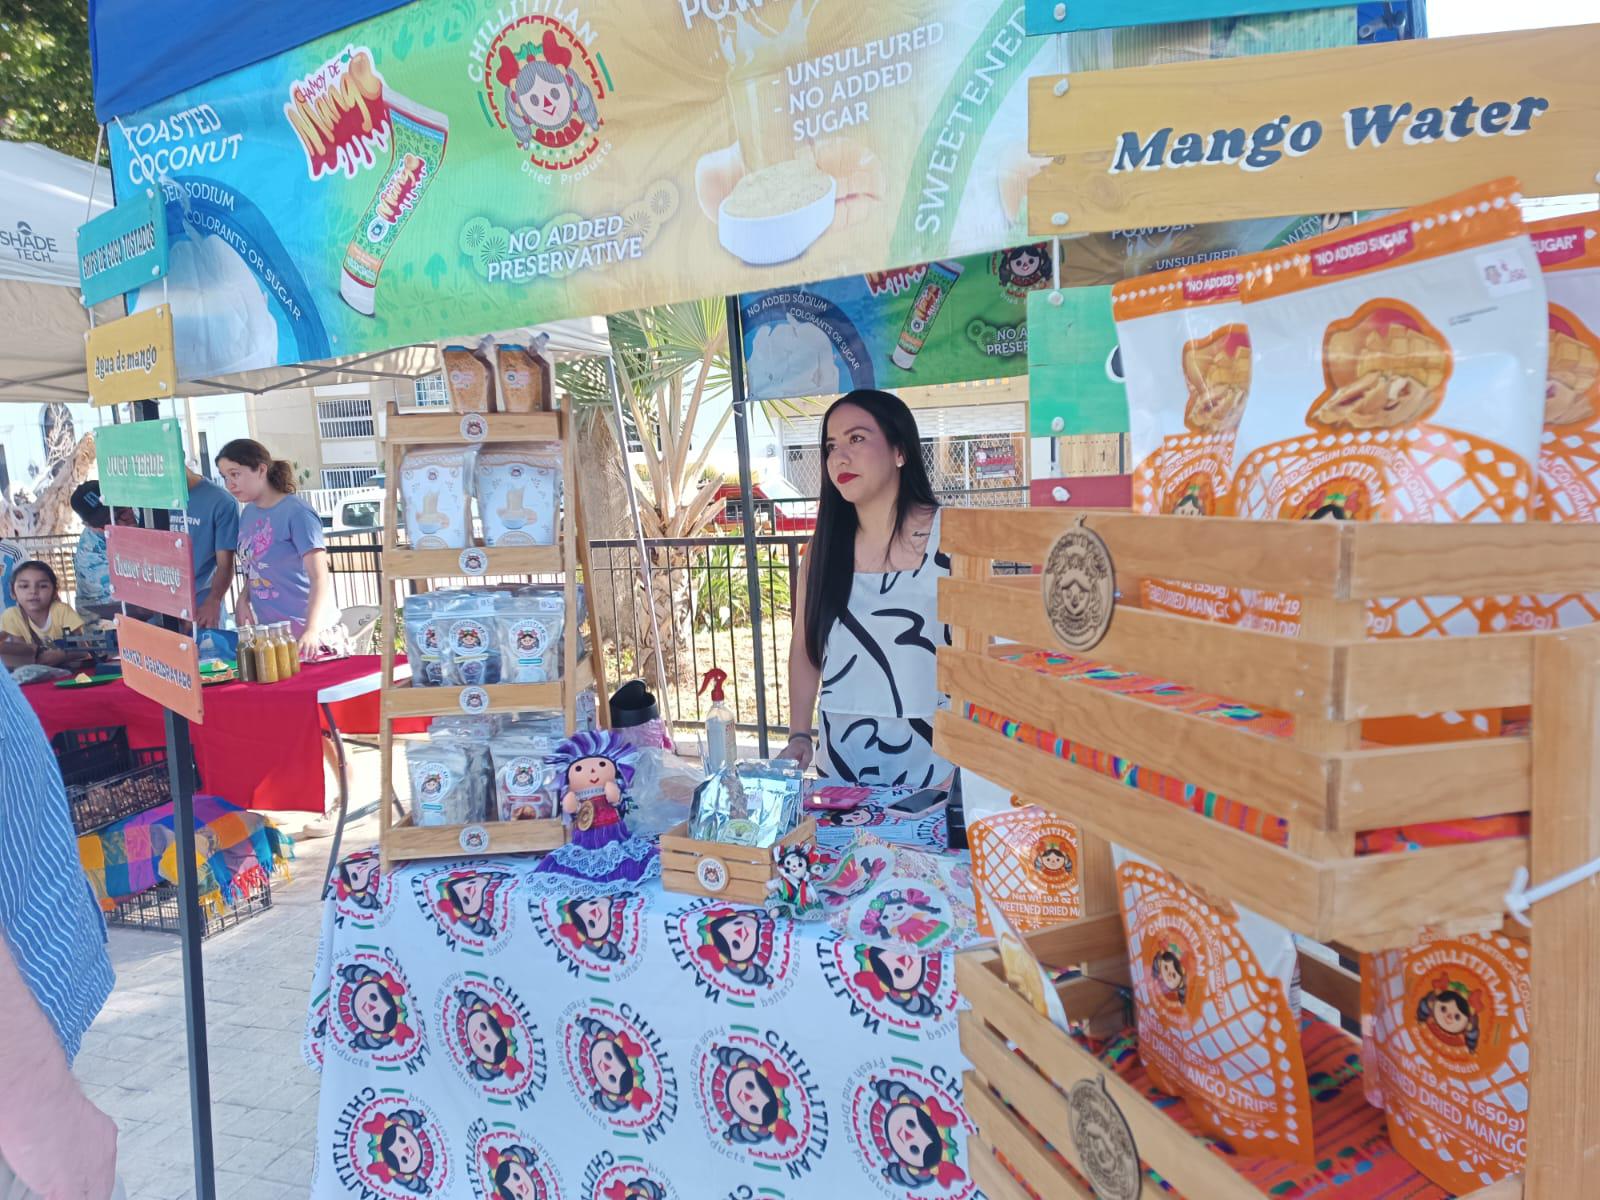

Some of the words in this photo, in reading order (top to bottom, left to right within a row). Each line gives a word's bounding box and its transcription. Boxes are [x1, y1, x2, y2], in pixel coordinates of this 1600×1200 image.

[786, 21, 944, 86] UNSULFURED
[788, 87, 824, 115] NO
[831, 60, 913, 104] ADDED
[123, 104, 221, 151] TOASTED
[792, 101, 869, 142] SUGAR
[1108, 113, 1322, 174] Mango
[1343, 96, 1549, 150] Water
[129, 133, 243, 185] COCONUT
[185, 182, 234, 211] SODIUM
[0, 230, 59, 253] SHADE
[508, 230, 541, 254] NO
[546, 215, 624, 246] ADDED
[1335, 238, 1367, 261] ADDED
[185, 210, 247, 254] COLORANTS
[248, 249, 264, 272] OR
[265, 268, 301, 321] SUGAR
[487, 236, 643, 282] PRESERVATIVE
[747, 305, 760, 317] NO
[761, 293, 790, 310] ADDED
[792, 293, 827, 312] SODIUM
[789, 307, 833, 335] COLORANTS
[832, 331, 842, 345] OR
[840, 341, 860, 370] SUGAR
[997, 329, 1016, 341] NO
[115, 349, 126, 373] de
[127, 344, 158, 374] mango
[1412, 949, 1509, 1017] CHILLITITLAN
[493, 976, 548, 1111] CHILLITITLAN
[619, 1003, 679, 1144] CHILLITITLAN
[765, 1029, 830, 1180] CHILLITITLAN
[1227, 1086, 1279, 1113] STRIPS
[1419, 1087, 1463, 1125] DRIED
[1472, 1099, 1526, 1133] (550g)
